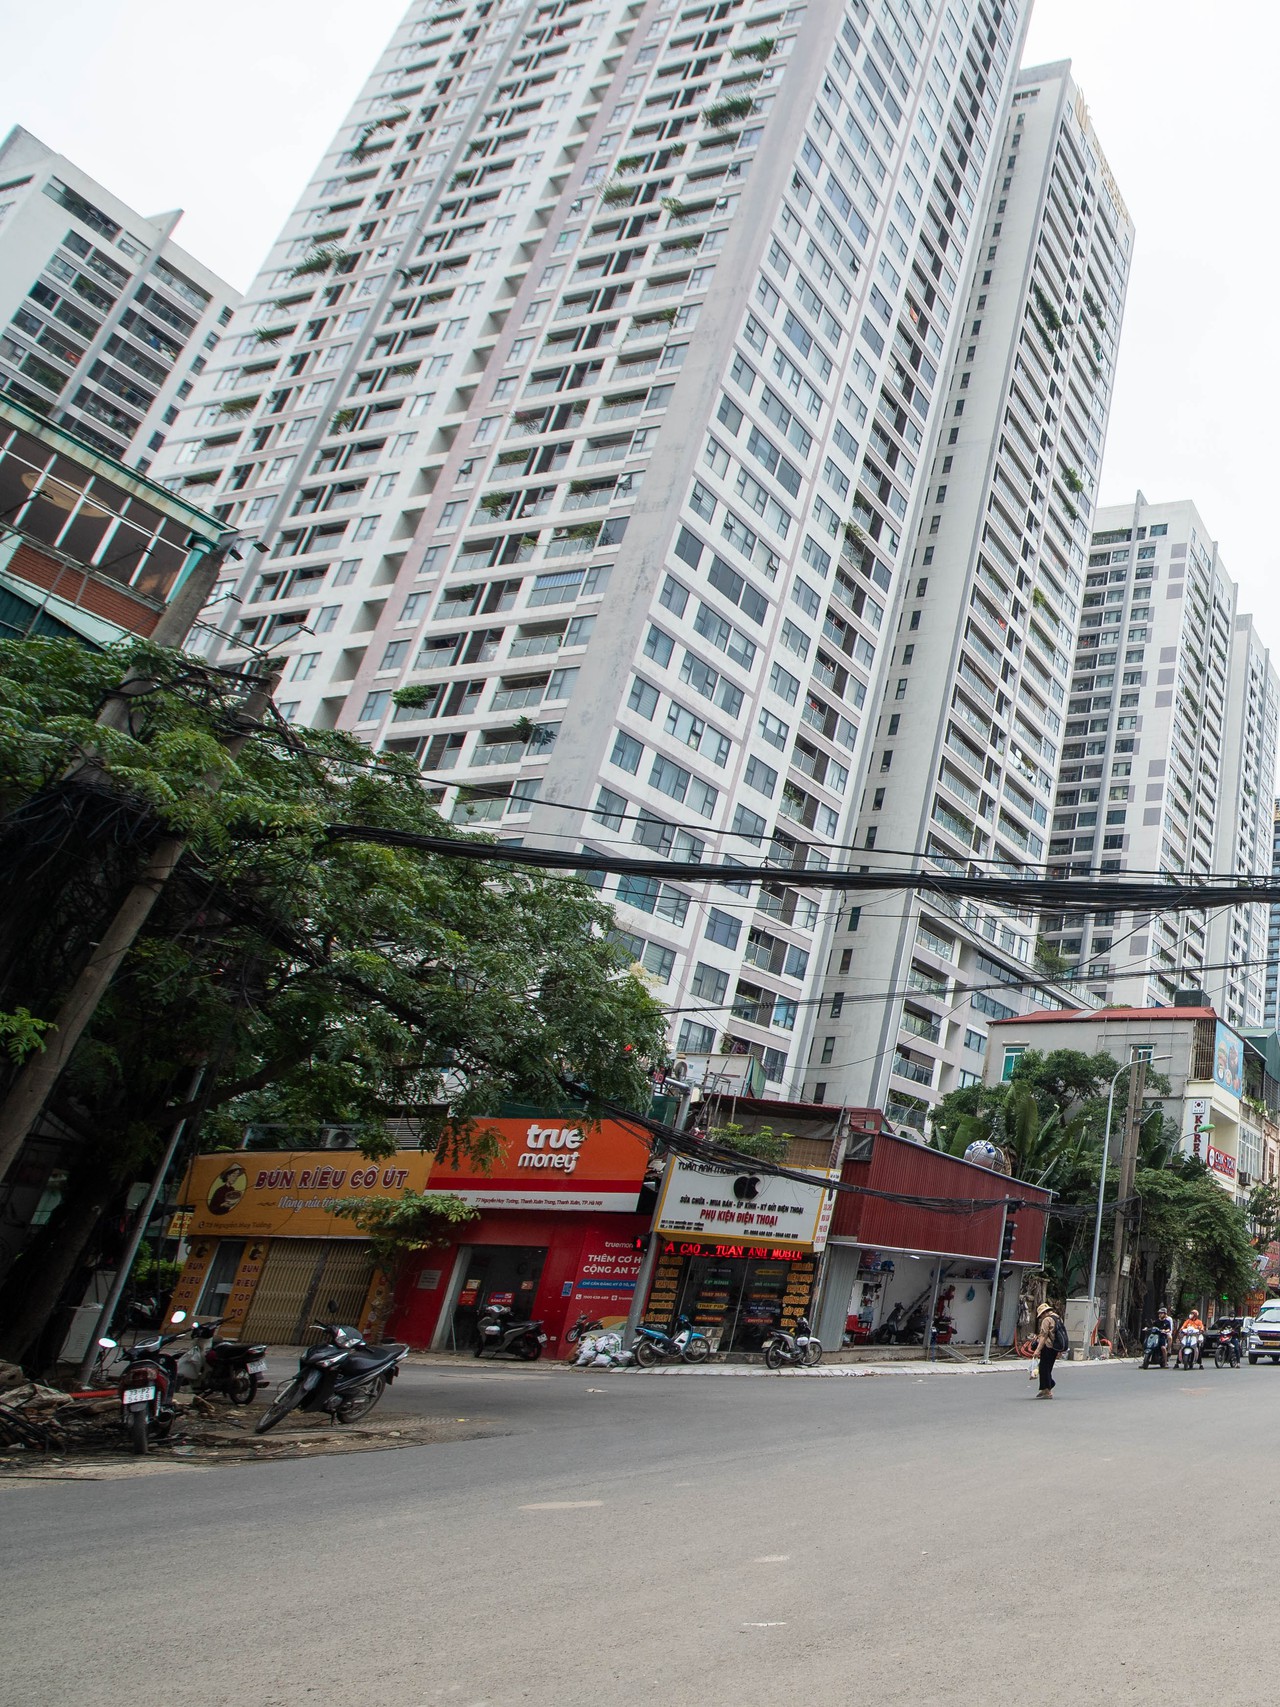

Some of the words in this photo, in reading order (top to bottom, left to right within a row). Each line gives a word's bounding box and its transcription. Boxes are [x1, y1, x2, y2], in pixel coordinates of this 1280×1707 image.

[526, 1124, 586, 1149] true
[518, 1151, 581, 1174] money
[254, 1166, 295, 1190] BÚN
[350, 1165, 380, 1189] CÔ
[382, 1164, 409, 1189] ÚT
[700, 1209, 716, 1223] PHỤ
[717, 1209, 736, 1224] KIỆN
[736, 1211, 756, 1225] ĐIỆN
[756, 1213, 779, 1228] THOẠI
[588, 1253, 616, 1263] THÊM
[617, 1255, 632, 1263] CƠ
[748, 1247, 768, 1257] ANH
[583, 1264, 612, 1275] CỘNG
[613, 1266, 628, 1274] AN
